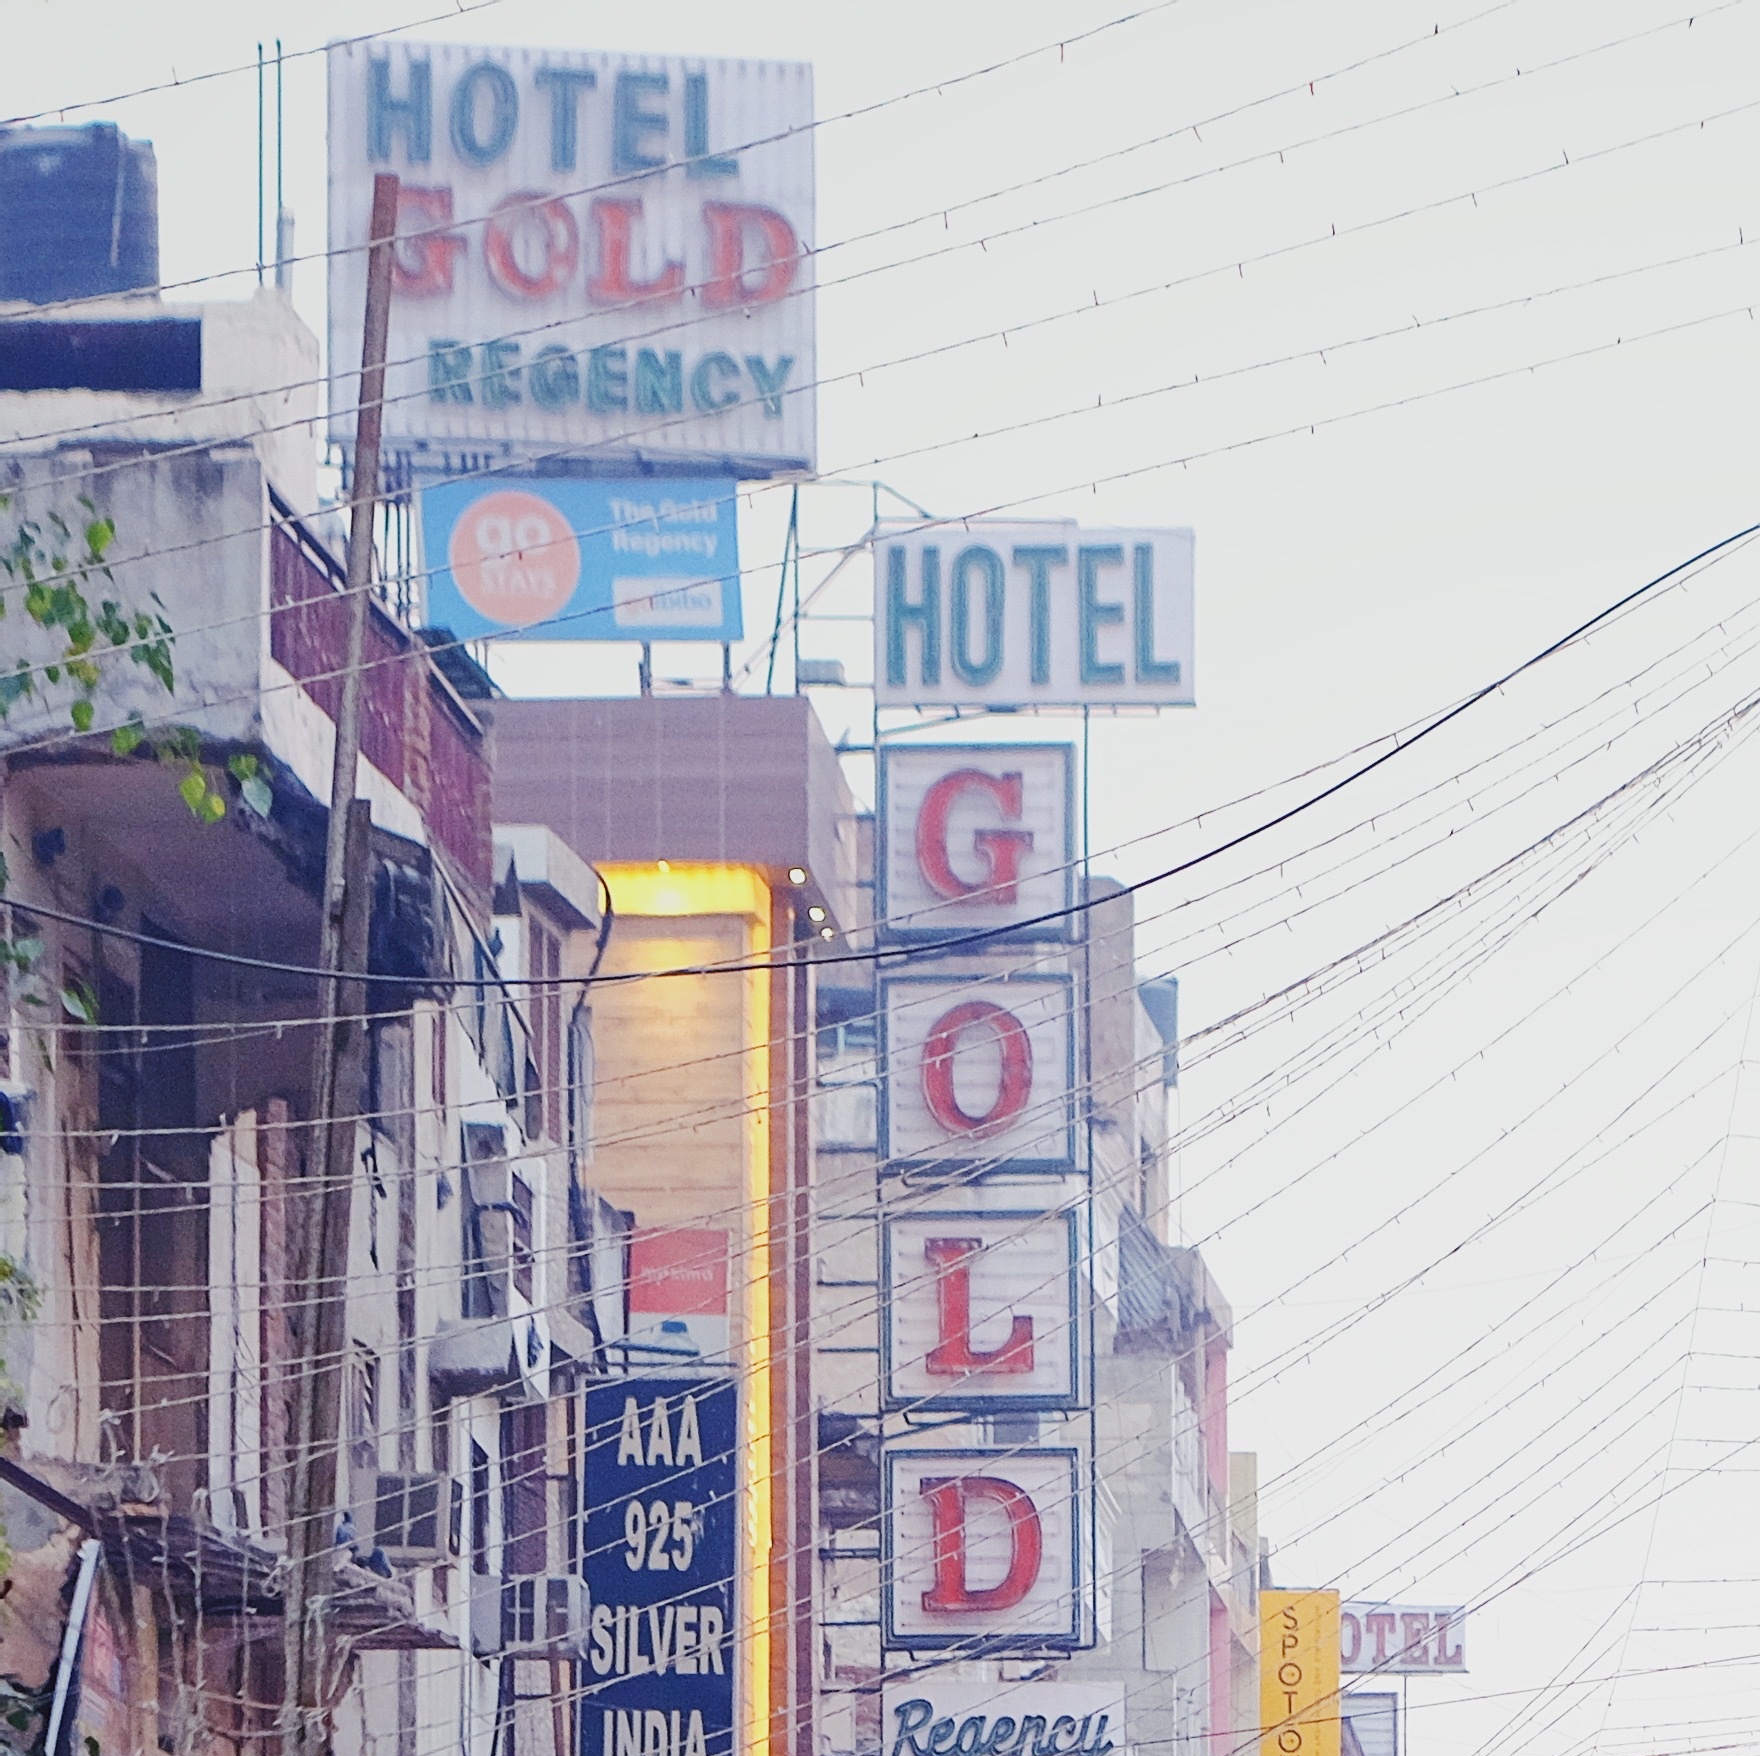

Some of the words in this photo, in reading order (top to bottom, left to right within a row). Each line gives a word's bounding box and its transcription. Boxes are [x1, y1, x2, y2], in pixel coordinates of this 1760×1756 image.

[365, 55, 741, 180] HOTEL
[388, 184, 798, 309] GOLD
[427, 337, 794, 419] REGENCY
[884, 541, 1181, 688] HOTEL
[914, 768, 1042, 1613] GOLD
[616, 1395, 704, 1467] AAA
[624, 1501, 695, 1573] 925
[591, 1605, 725, 1677] SILVER
[1341, 1613, 1462, 1666] OTEL
